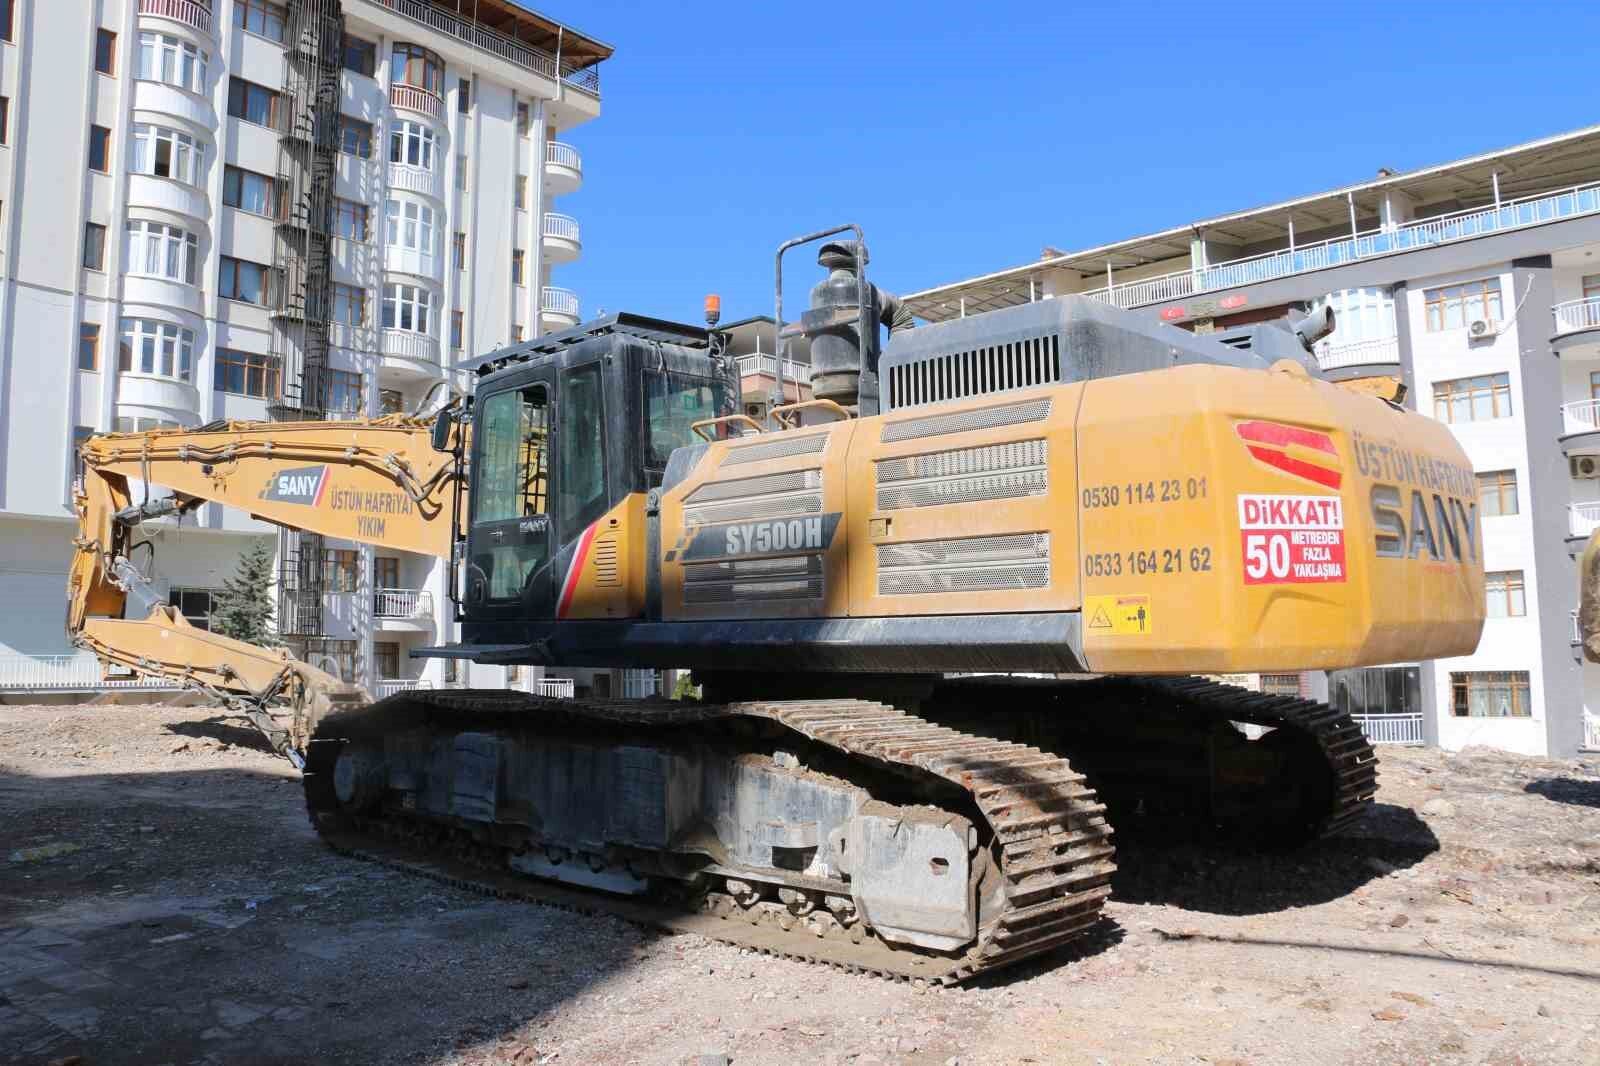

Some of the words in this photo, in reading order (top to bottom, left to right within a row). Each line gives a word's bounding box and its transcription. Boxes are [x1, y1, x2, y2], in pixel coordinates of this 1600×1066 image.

[278, 475, 318, 496] SANY
[1082, 486, 1119, 508] 0530
[1126, 481, 1155, 504] 114
[1161, 480, 1181, 501] 23
[1187, 477, 1207, 499] 01
[330, 486, 363, 511] ÜSTÜN
[357, 515, 385, 539] YIKIM
[1370, 483, 1476, 563] SANY
[726, 518, 822, 554] SY500H
[1291, 530, 1340, 545] METREDEN
[1085, 553, 1122, 577] 0533
[1128, 550, 1157, 575] 164
[1163, 548, 1182, 573] 21
[1190, 547, 1211, 571] 62
[1246, 534, 1290, 578] 50
[1303, 547, 1331, 561] FAZLA
[1293, 563, 1342, 580] YAKLAŞMA
